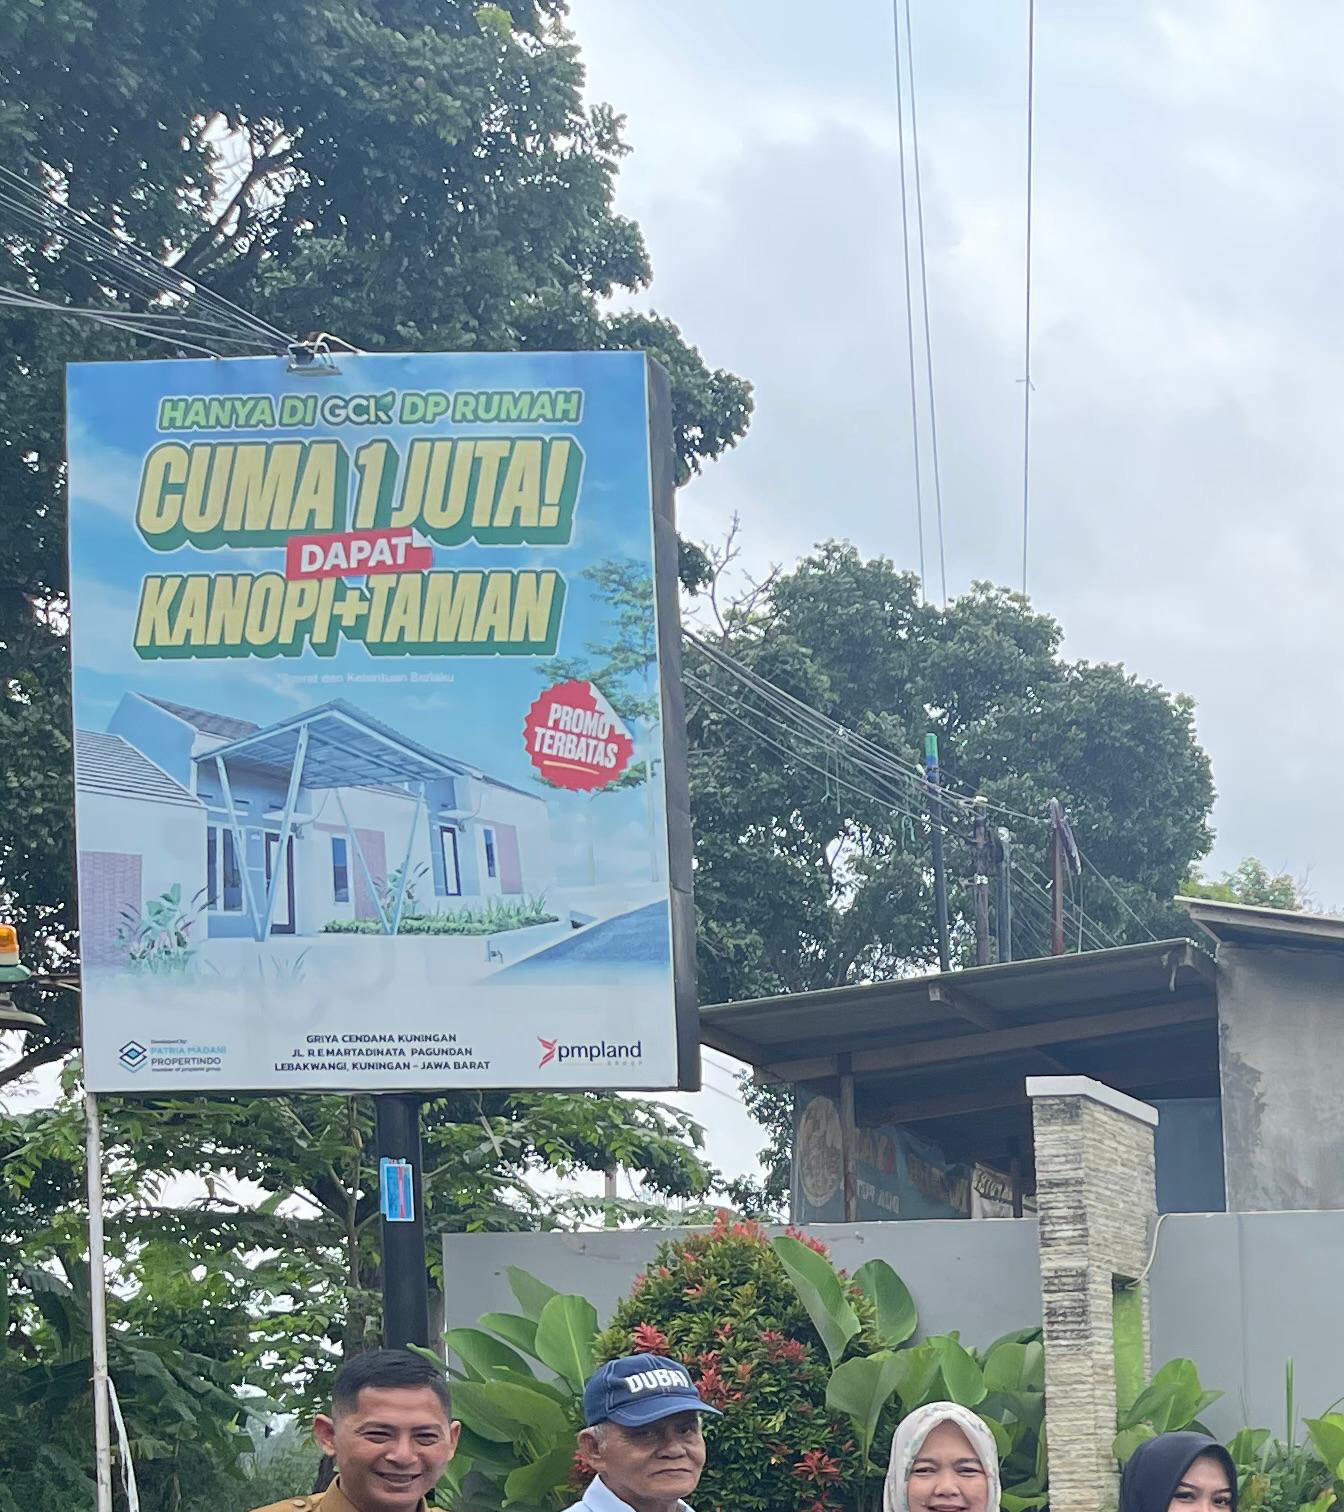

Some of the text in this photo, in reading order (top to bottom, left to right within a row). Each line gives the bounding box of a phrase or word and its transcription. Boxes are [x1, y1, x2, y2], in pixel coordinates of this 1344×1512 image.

[162, 390, 582, 428] HANYA DI GCK DP RUMAH
[138, 439, 572, 535] CUMA 1 JUTA!
[300, 535, 412, 574] DAPAT
[547, 702, 611, 741] PROMO
[533, 726, 619, 769] TERBATAS
[306, 1033, 457, 1043] GRIYA CENDANA KUNINGAN
[557, 1040, 642, 1062] pmpland
[151, 1057, 222, 1066] PROPERTINDO
[410, 1047, 473, 1057] PAGUNDAN
[352, 1062, 410, 1071] KUNINGAN
[420, 1061, 451, 1070] JAWA
[453, 1061, 490, 1070] BARAT
[624, 1368, 690, 1394] DUBAI
